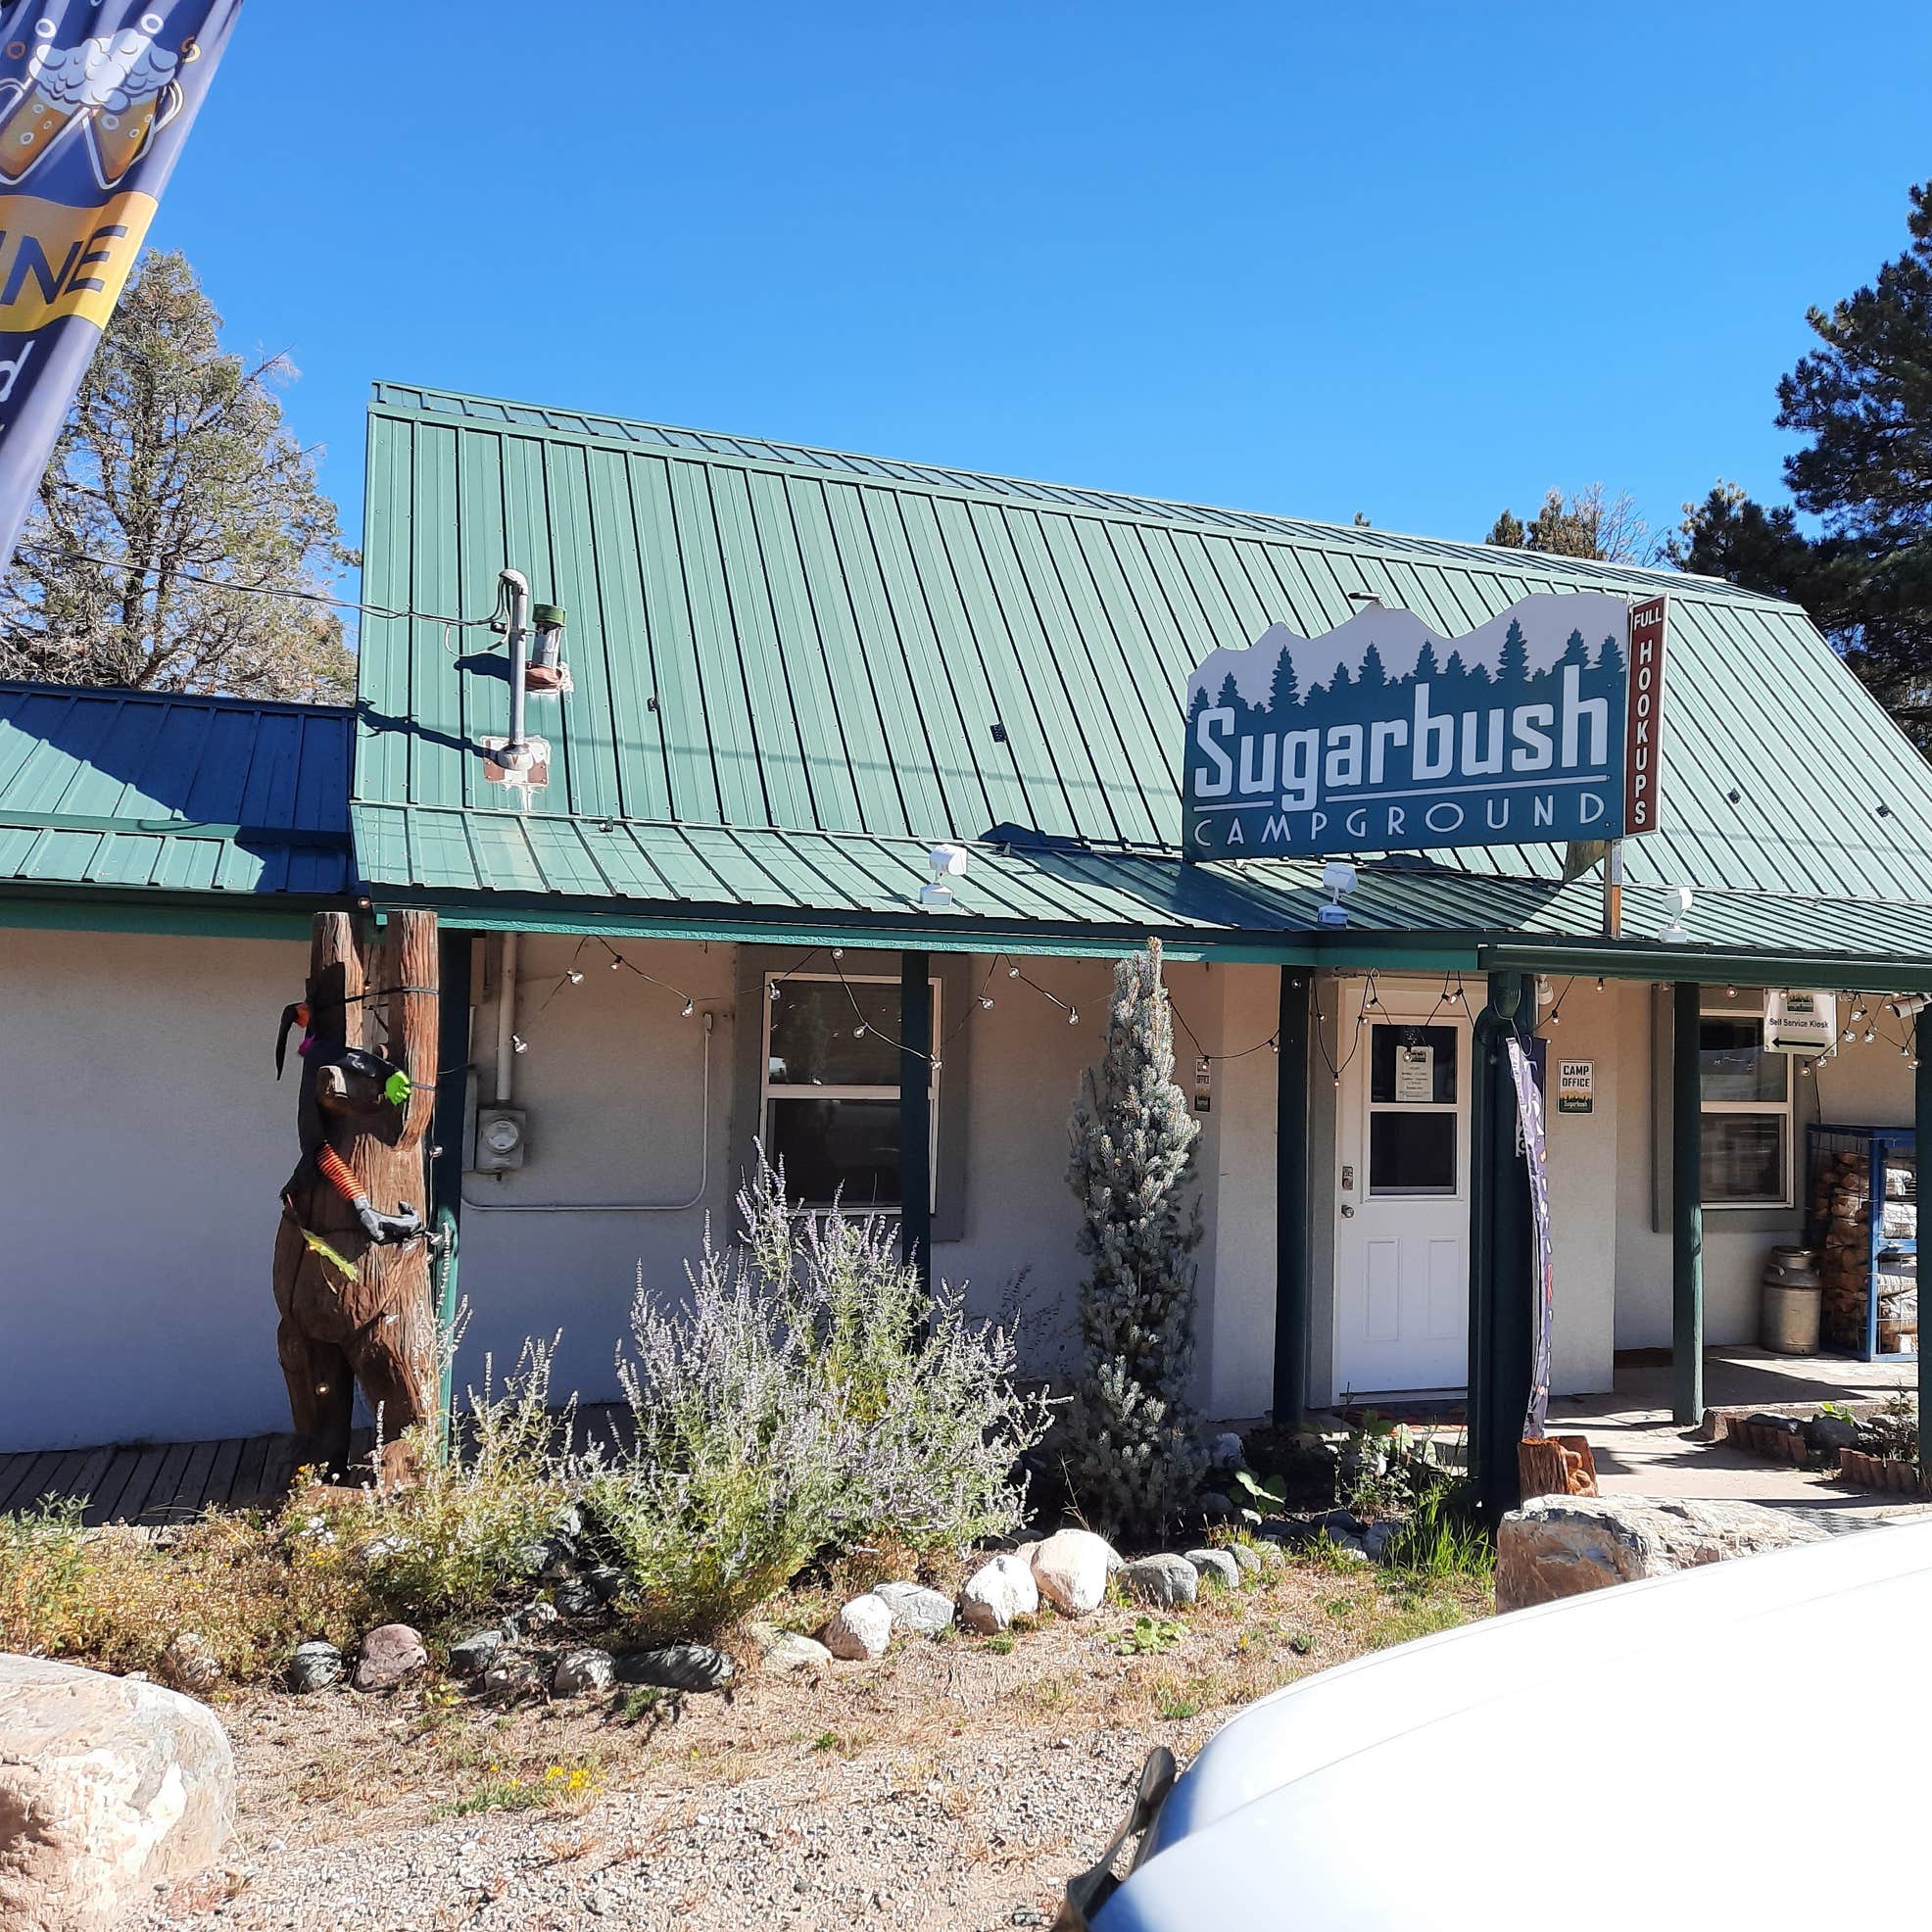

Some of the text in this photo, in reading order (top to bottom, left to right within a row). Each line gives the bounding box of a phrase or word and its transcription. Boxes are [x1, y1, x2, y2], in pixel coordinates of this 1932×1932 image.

[0, 224, 128, 306] NE
[1633, 606, 1663, 630] FULL
[1193, 664, 1610, 813] Sugarbush
[1634, 639, 1654, 826] HOOKUPS
[1193, 792, 1606, 847] CAMPGROUND
[1783, 1019, 1809, 1028] Service
[1810, 1020, 1829, 1029] Kiosk
[1562, 1078, 1591, 1087] OFFICE
[1563, 1065, 1589, 1076] CAMP
